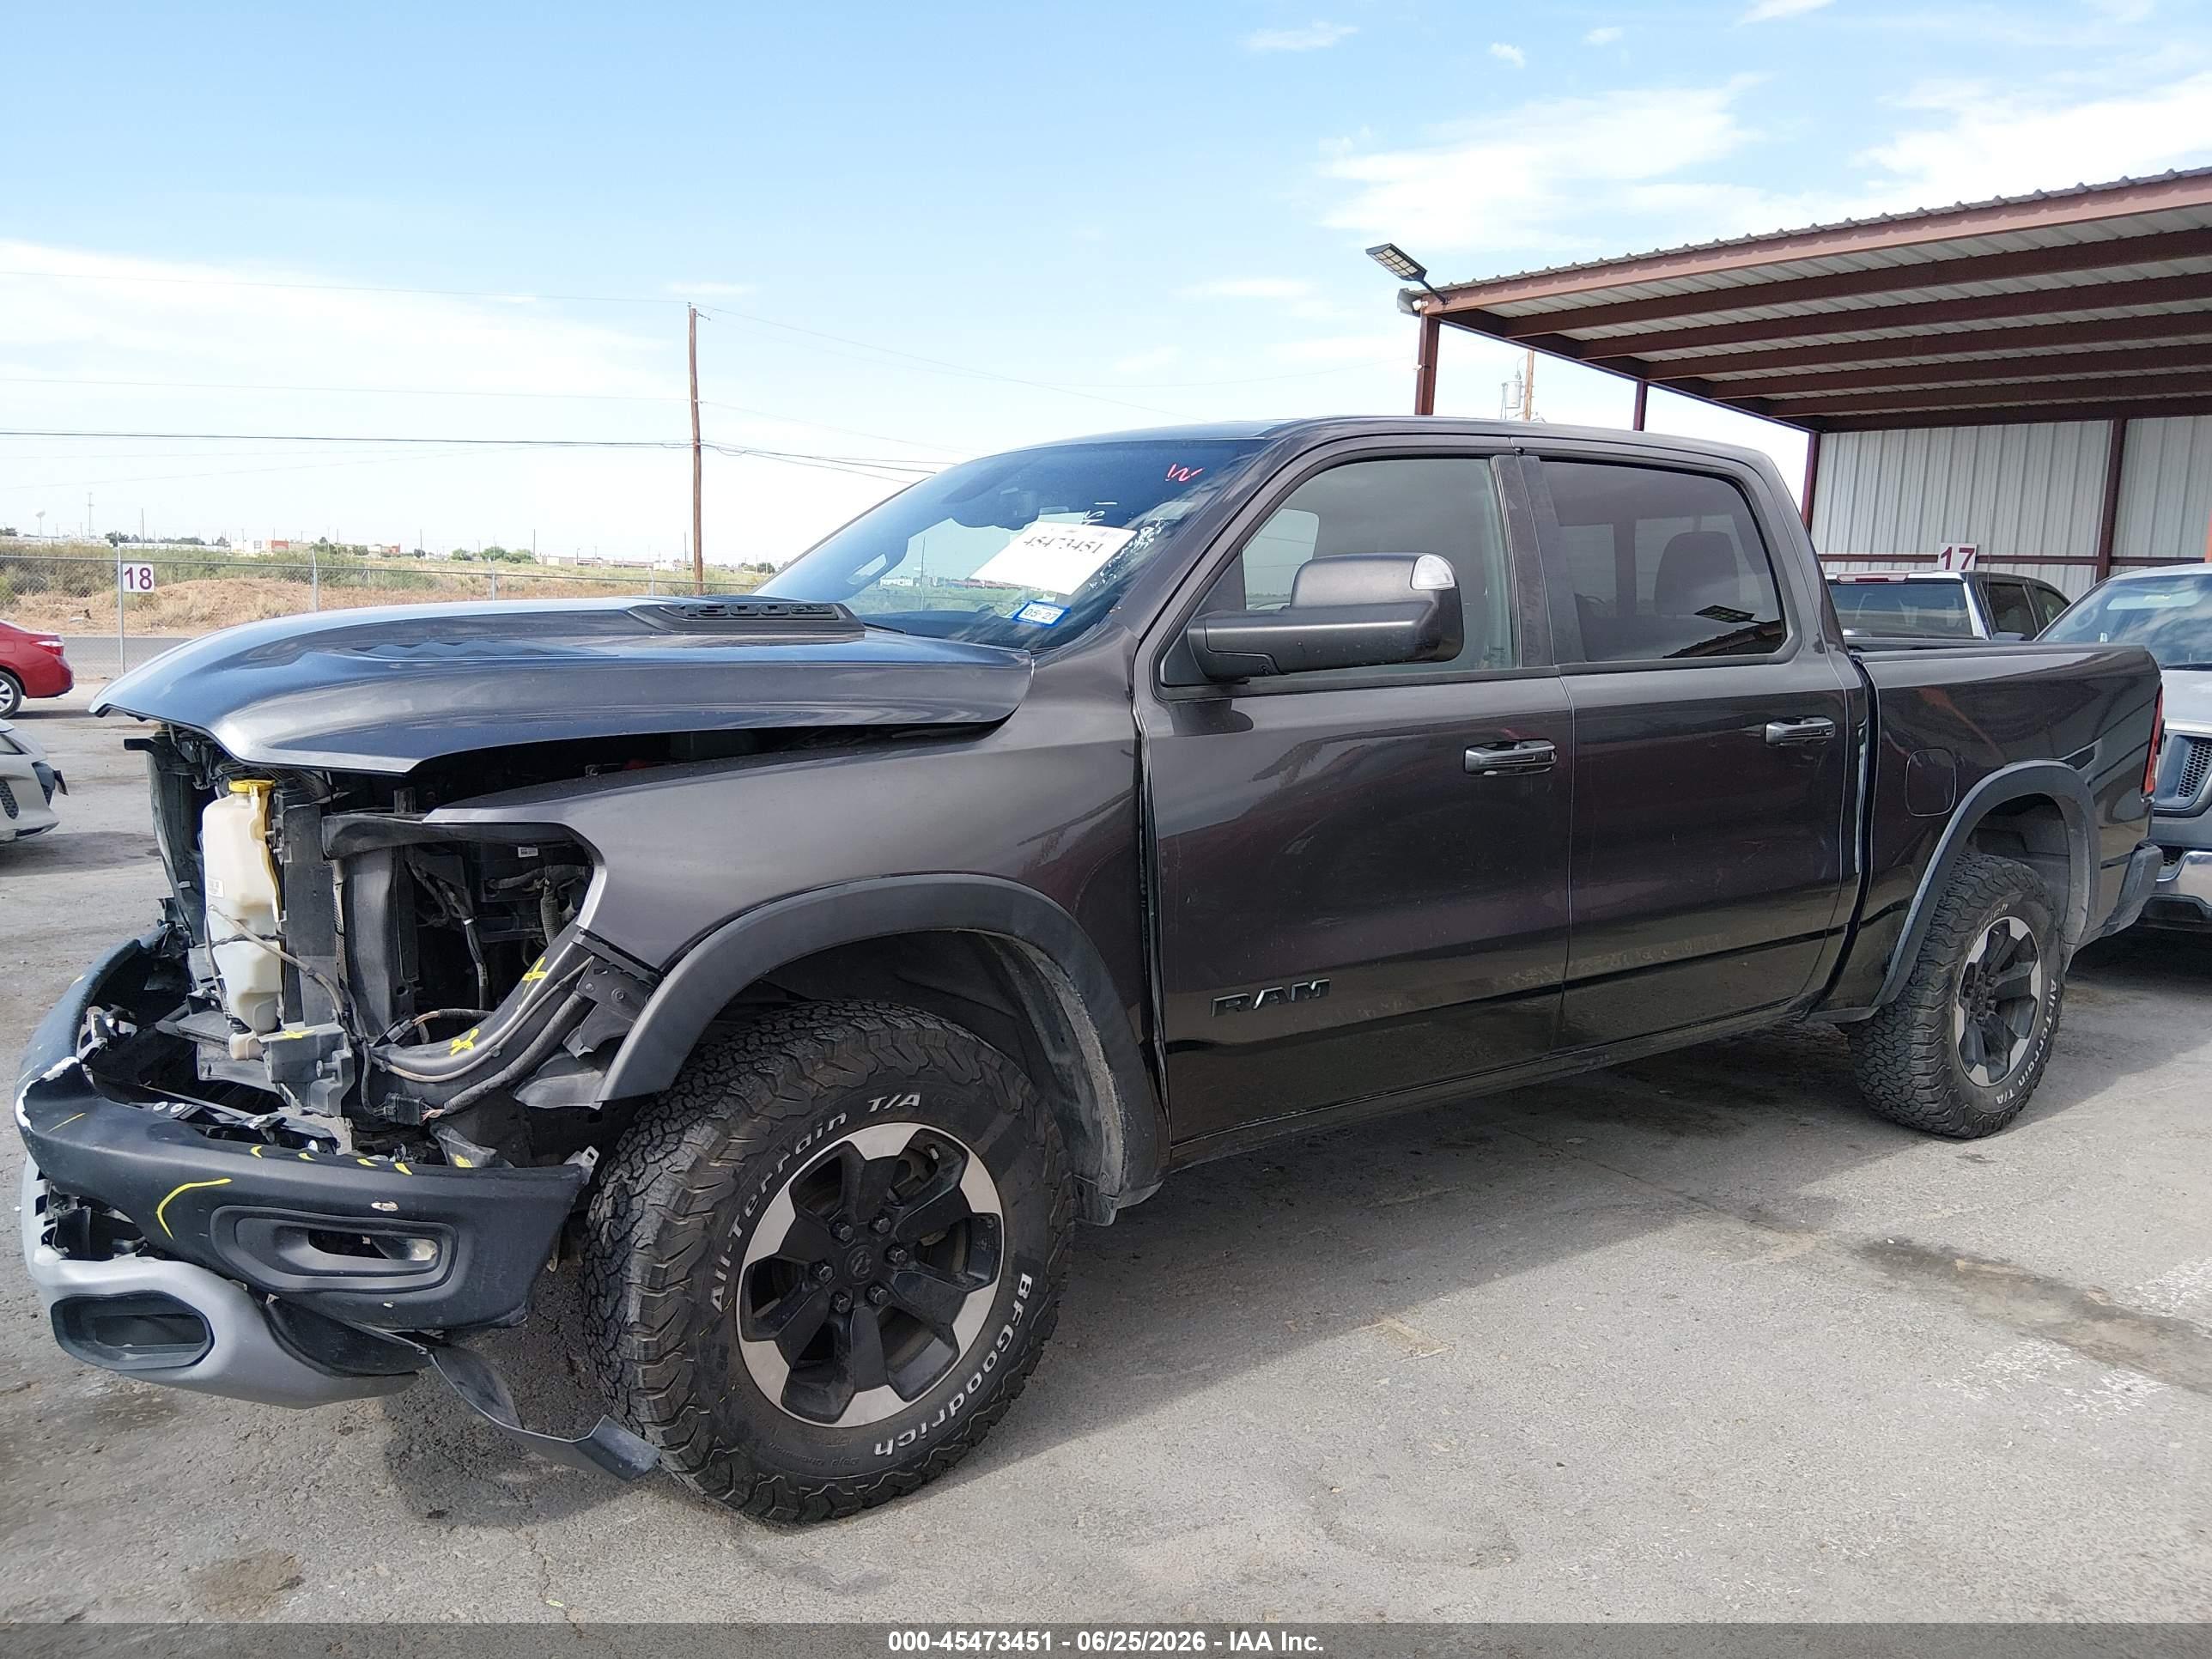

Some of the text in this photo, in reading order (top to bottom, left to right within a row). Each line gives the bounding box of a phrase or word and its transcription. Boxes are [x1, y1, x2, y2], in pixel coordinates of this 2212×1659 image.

[1940, 546, 1975, 570] 17
[124, 567, 153, 590] 18
[1212, 979, 1330, 1018] RAM
[710, 1093, 921, 1314] All-Terrain T/A
[873, 1273, 1033, 1457] BFGoodrich
